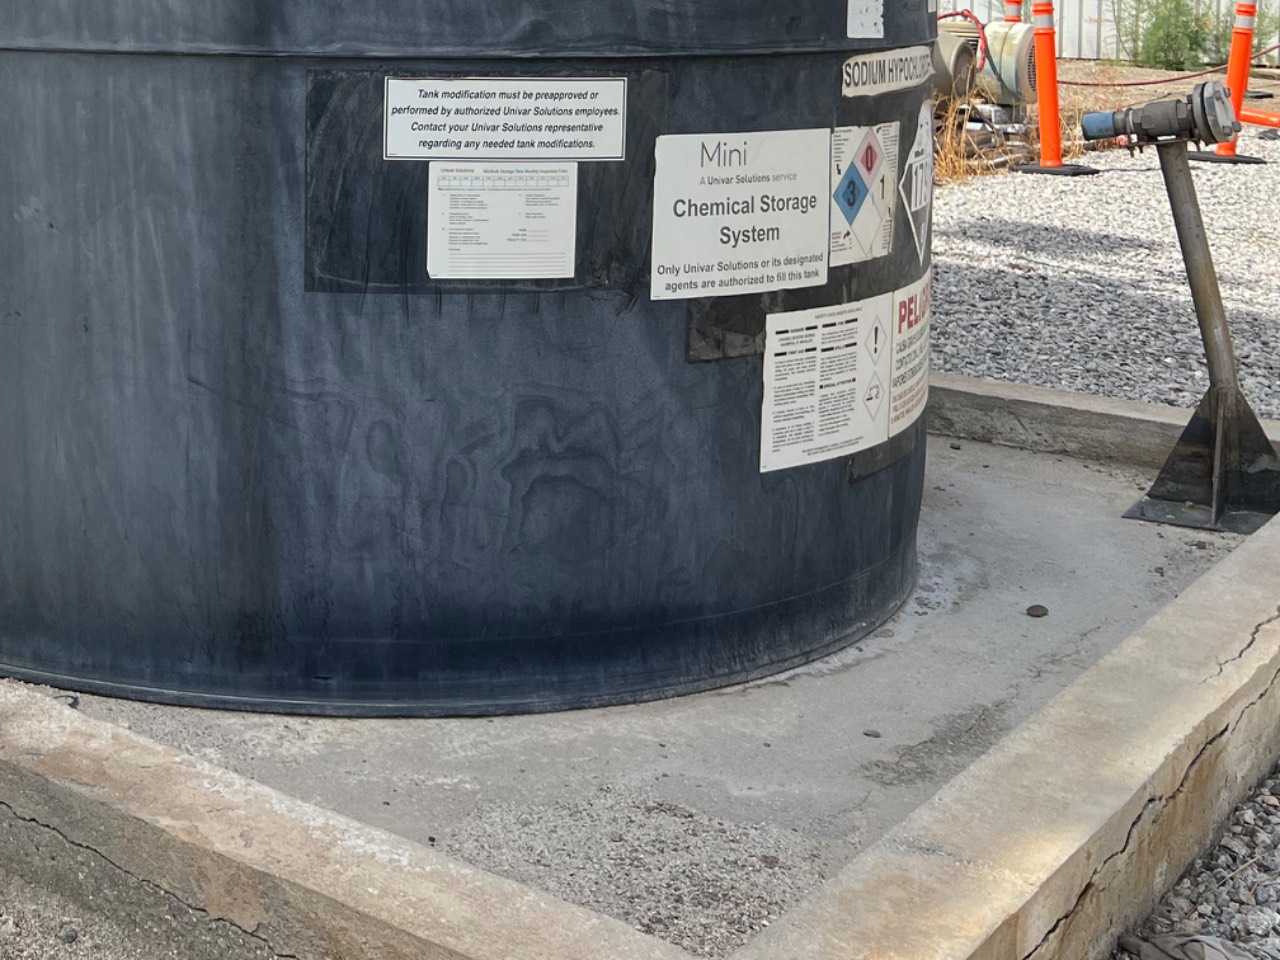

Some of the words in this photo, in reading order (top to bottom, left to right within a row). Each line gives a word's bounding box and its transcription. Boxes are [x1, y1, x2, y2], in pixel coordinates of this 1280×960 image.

[844, 60, 886, 87] SODIUM
[418, 90, 439, 99] Tank
[441, 90, 496, 100] modification
[498, 90, 520, 100] must
[522, 90, 533, 100] be
[535, 90, 588, 101] preapproved
[392, 106, 438, 115] performed
[441, 106, 452, 116] by
[454, 106, 501, 116] authorized
[504, 106, 530, 116] Univar
[534, 106, 573, 116] Solutions
[411, 122, 446, 132] Contact
[448, 124, 469, 133] your
[472, 122, 500, 132] Univar
[502, 122, 542, 132] Solutions
[545, 123, 603, 133] representative
[418, 139, 461, 149] regarding
[464, 141, 480, 149] any
[482, 139, 515, 148] needed
[517, 140, 534, 148] tank
[537, 140, 595, 148] modifications.
[700, 141, 747, 168] Mini
[865, 145, 874, 173] 0
[708, 176, 733, 185] Univar
[736, 174, 770, 184] Solutions
[772, 173, 797, 181] service
[879, 174, 885, 200] 1
[673, 196, 754, 217] Chemical
[760, 194, 817, 214] Storage
[847, 180, 857, 208] 3
[720, 226, 779, 248] System
[657, 264, 680, 276] Only
[683, 263, 714, 273] Univar
[717, 259, 758, 272] Solutions
[761, 260, 770, 268] or
[772, 257, 781, 266] its
[783, 252, 823, 268] designated
[665, 279, 698, 292] agents
[701, 280, 716, 288] are
[719, 274, 764, 287] authorized
[767, 274, 774, 282] to
[777, 271, 787, 281] fill
[788, 271, 802, 281] this
[804, 269, 819, 278] tank
